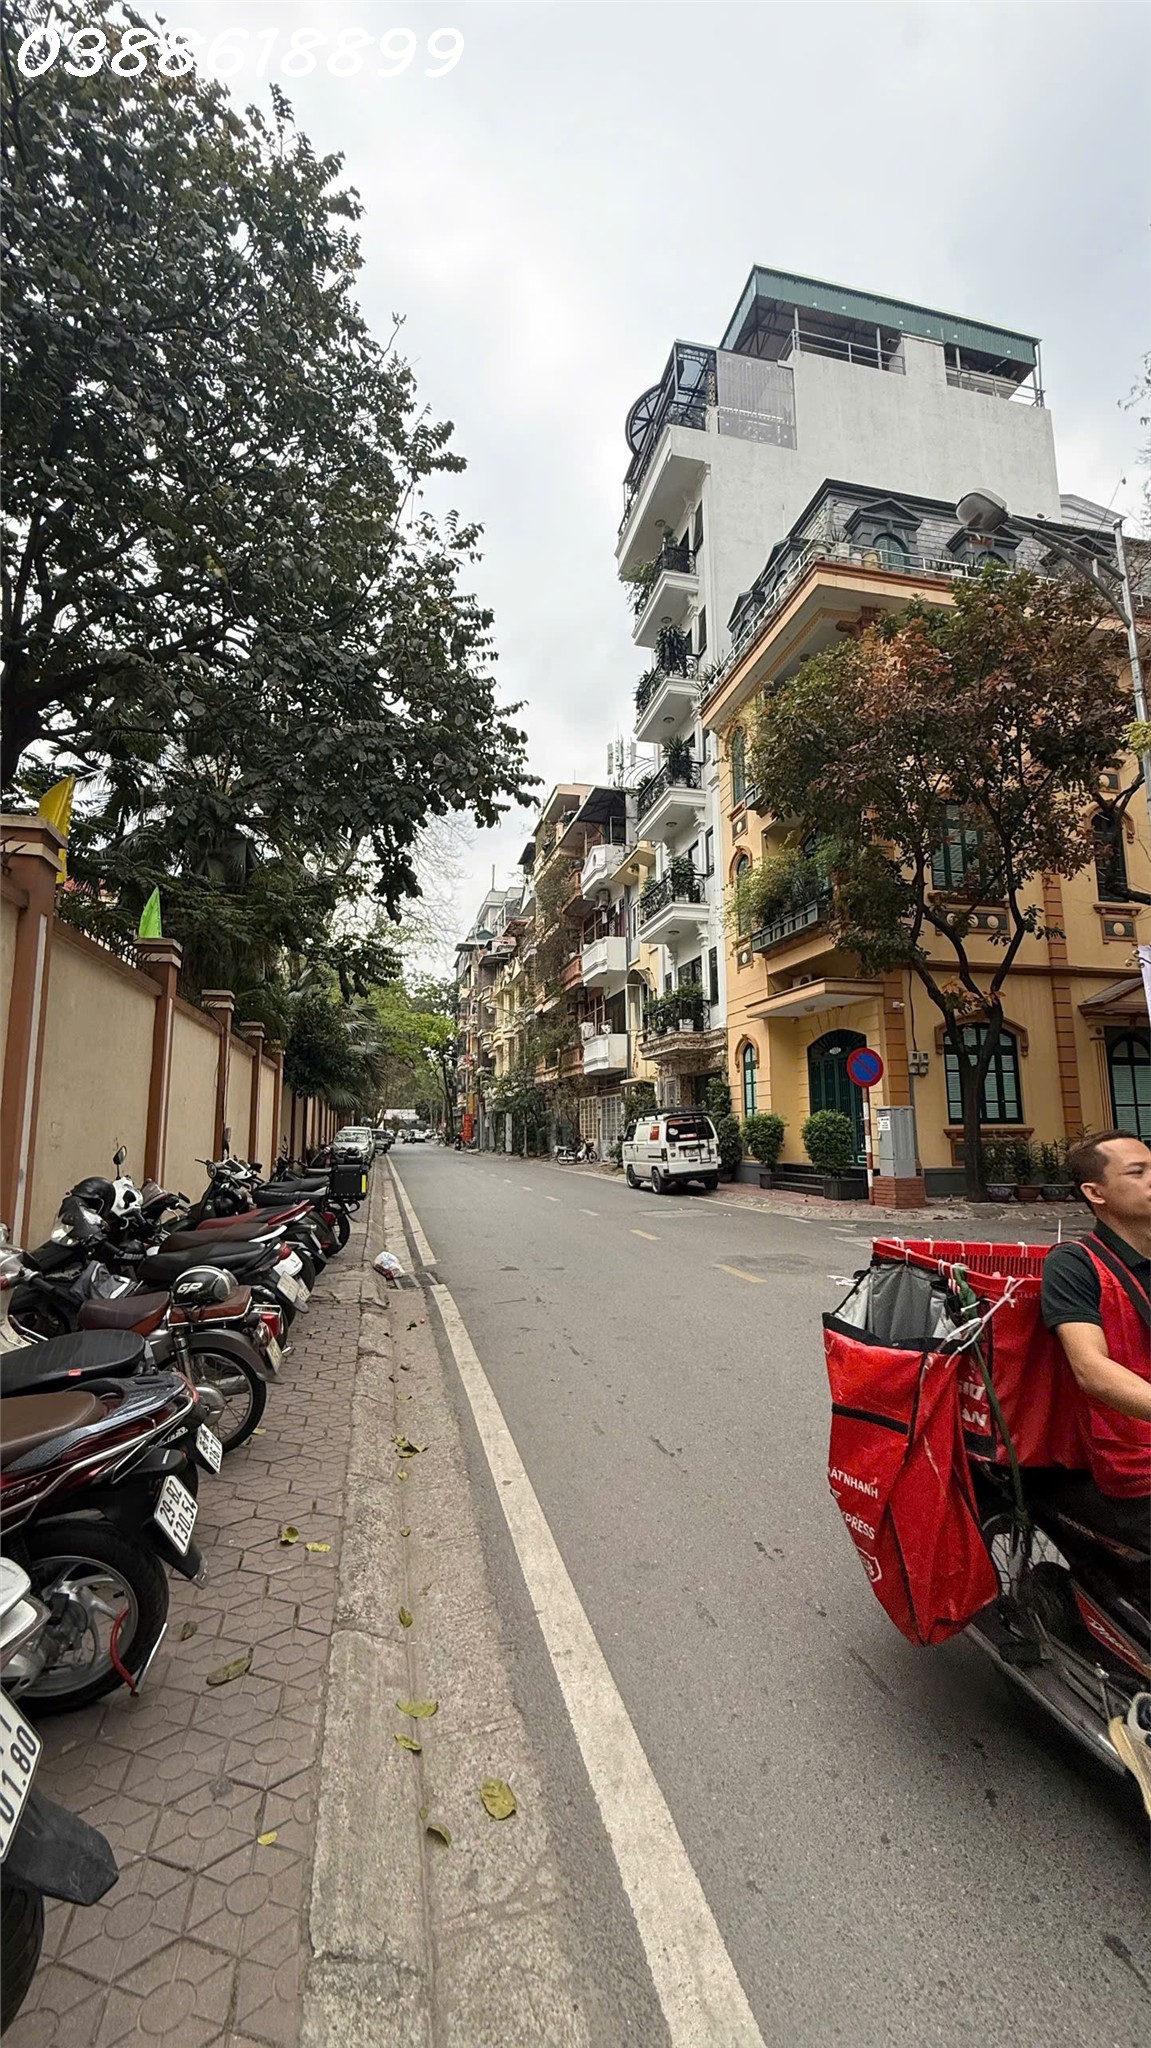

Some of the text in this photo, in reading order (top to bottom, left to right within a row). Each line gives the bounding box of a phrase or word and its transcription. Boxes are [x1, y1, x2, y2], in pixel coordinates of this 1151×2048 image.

[177, 1283, 203, 1295] GP
[160, 1479, 183, 1527] 29-B2
[173, 1497, 197, 1547] 130.54
